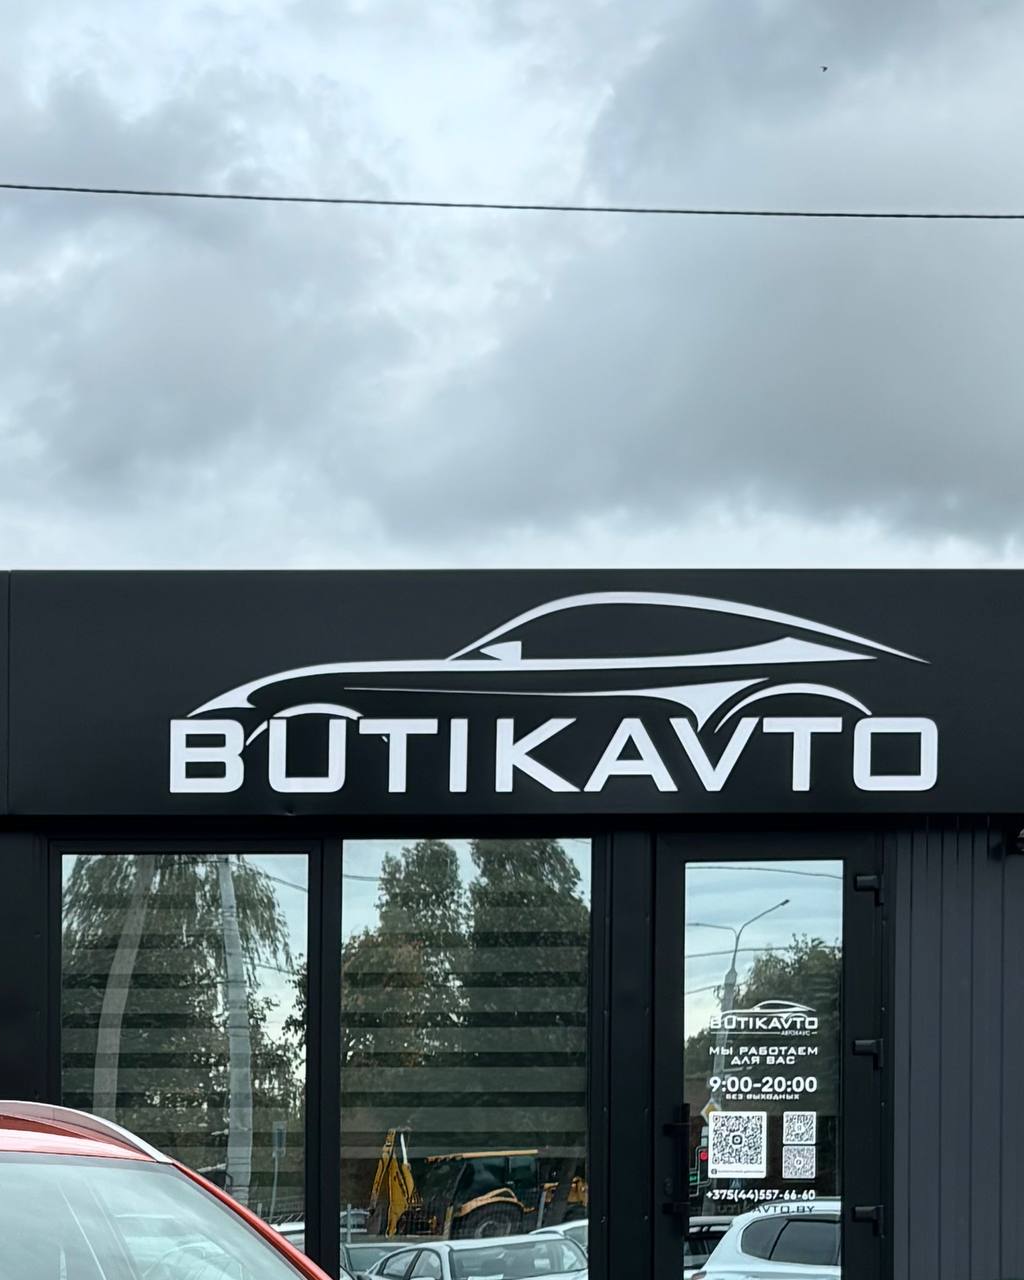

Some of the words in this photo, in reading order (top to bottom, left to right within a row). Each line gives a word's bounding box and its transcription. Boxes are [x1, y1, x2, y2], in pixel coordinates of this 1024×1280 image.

[169, 715, 939, 794] BUTIKAVTO
[710, 1016, 819, 1030] BUTIKAVTO
[709, 1046, 734, 1056] МЫ
[739, 1046, 818, 1056] РАБОТАЕМ
[730, 1056, 760, 1065] ДЛЯ
[766, 1056, 796, 1065] ВАС
[709, 1076, 818, 1093] 9:00-20:00
[706, 1189, 816, 1202] +375(44)557-66-60
